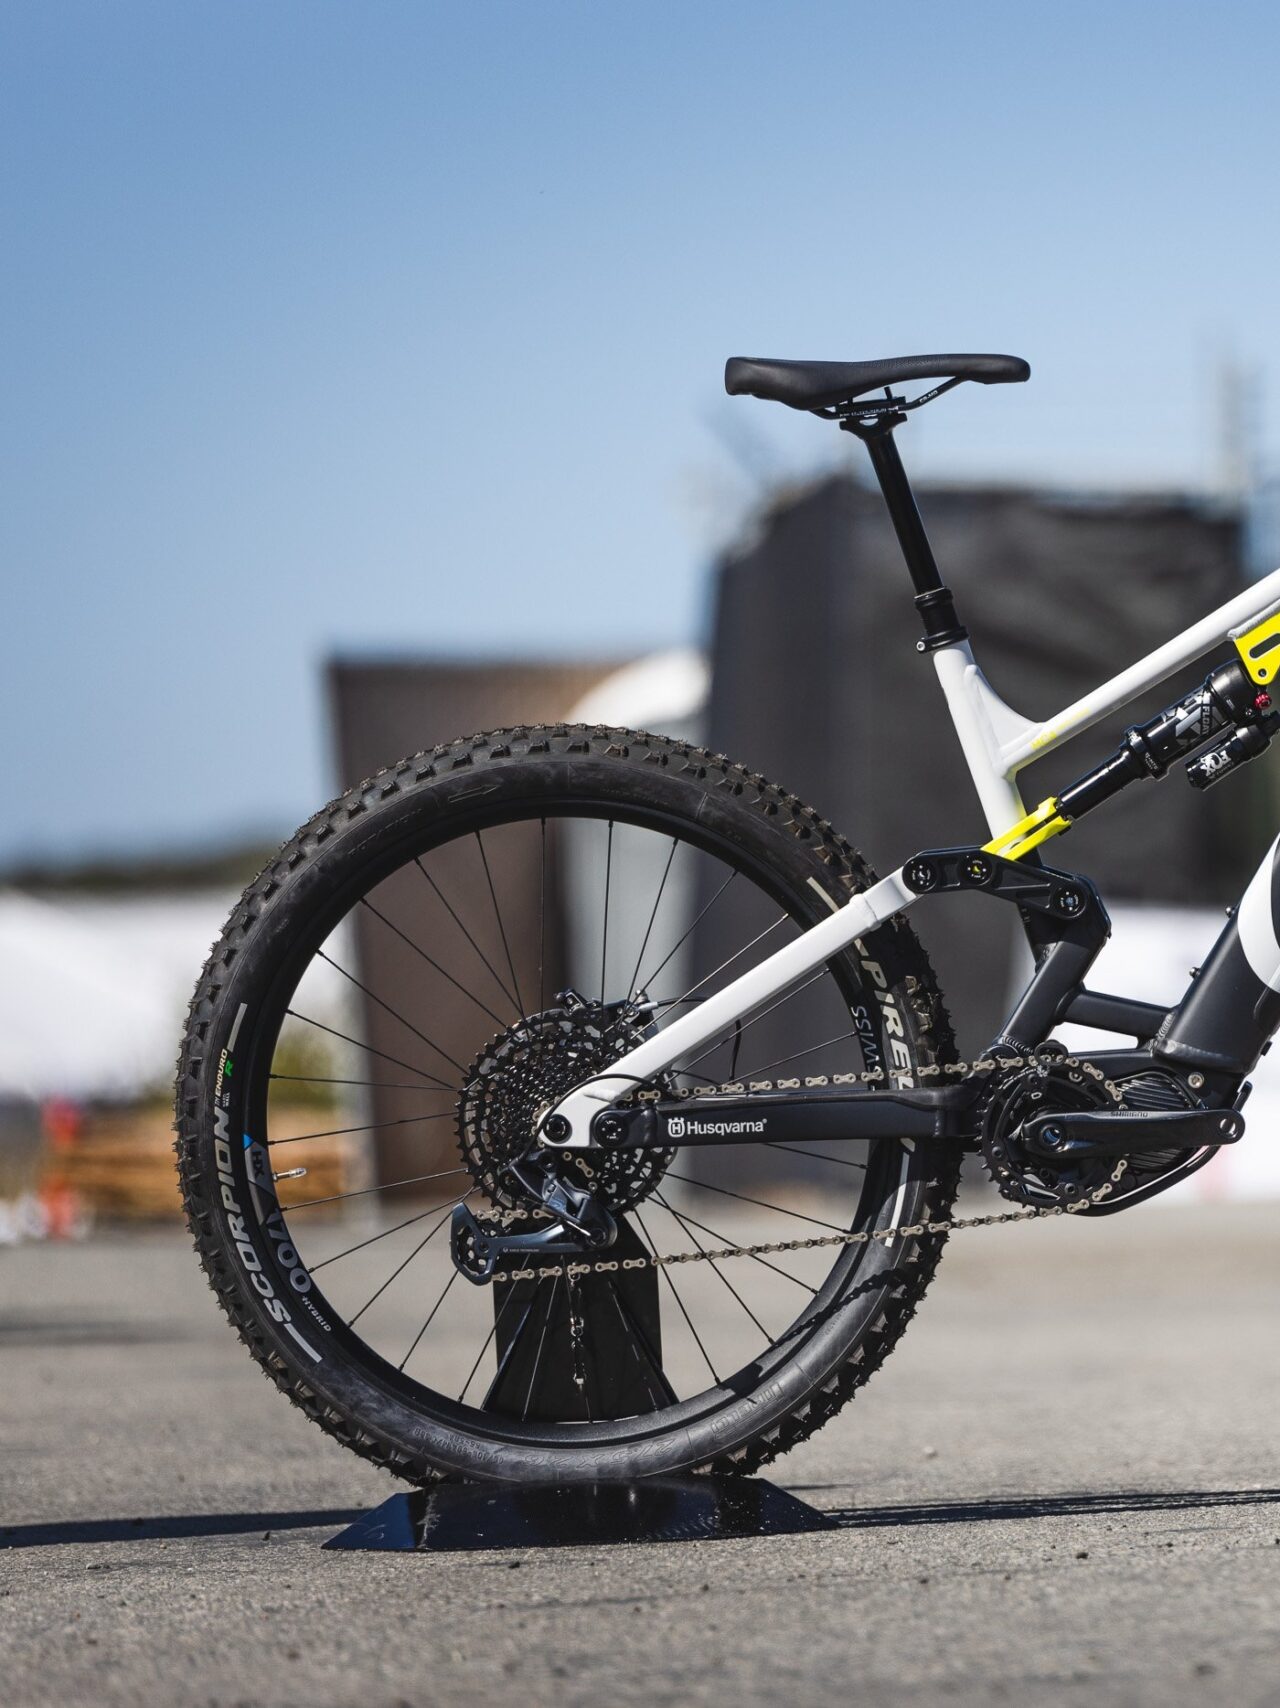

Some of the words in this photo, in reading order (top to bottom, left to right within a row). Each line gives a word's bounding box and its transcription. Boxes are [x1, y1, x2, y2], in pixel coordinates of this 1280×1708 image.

[1200, 749, 1232, 777] FOX
[860, 960, 915, 1090] PIREL
[215, 1048, 228, 1097] ENDURO
[687, 1120, 764, 1136] Husqvarna
[214, 1105, 292, 1323] SCORPION
[266, 1208, 311, 1293] 1700
[301, 1295, 332, 1332] HYBRID
